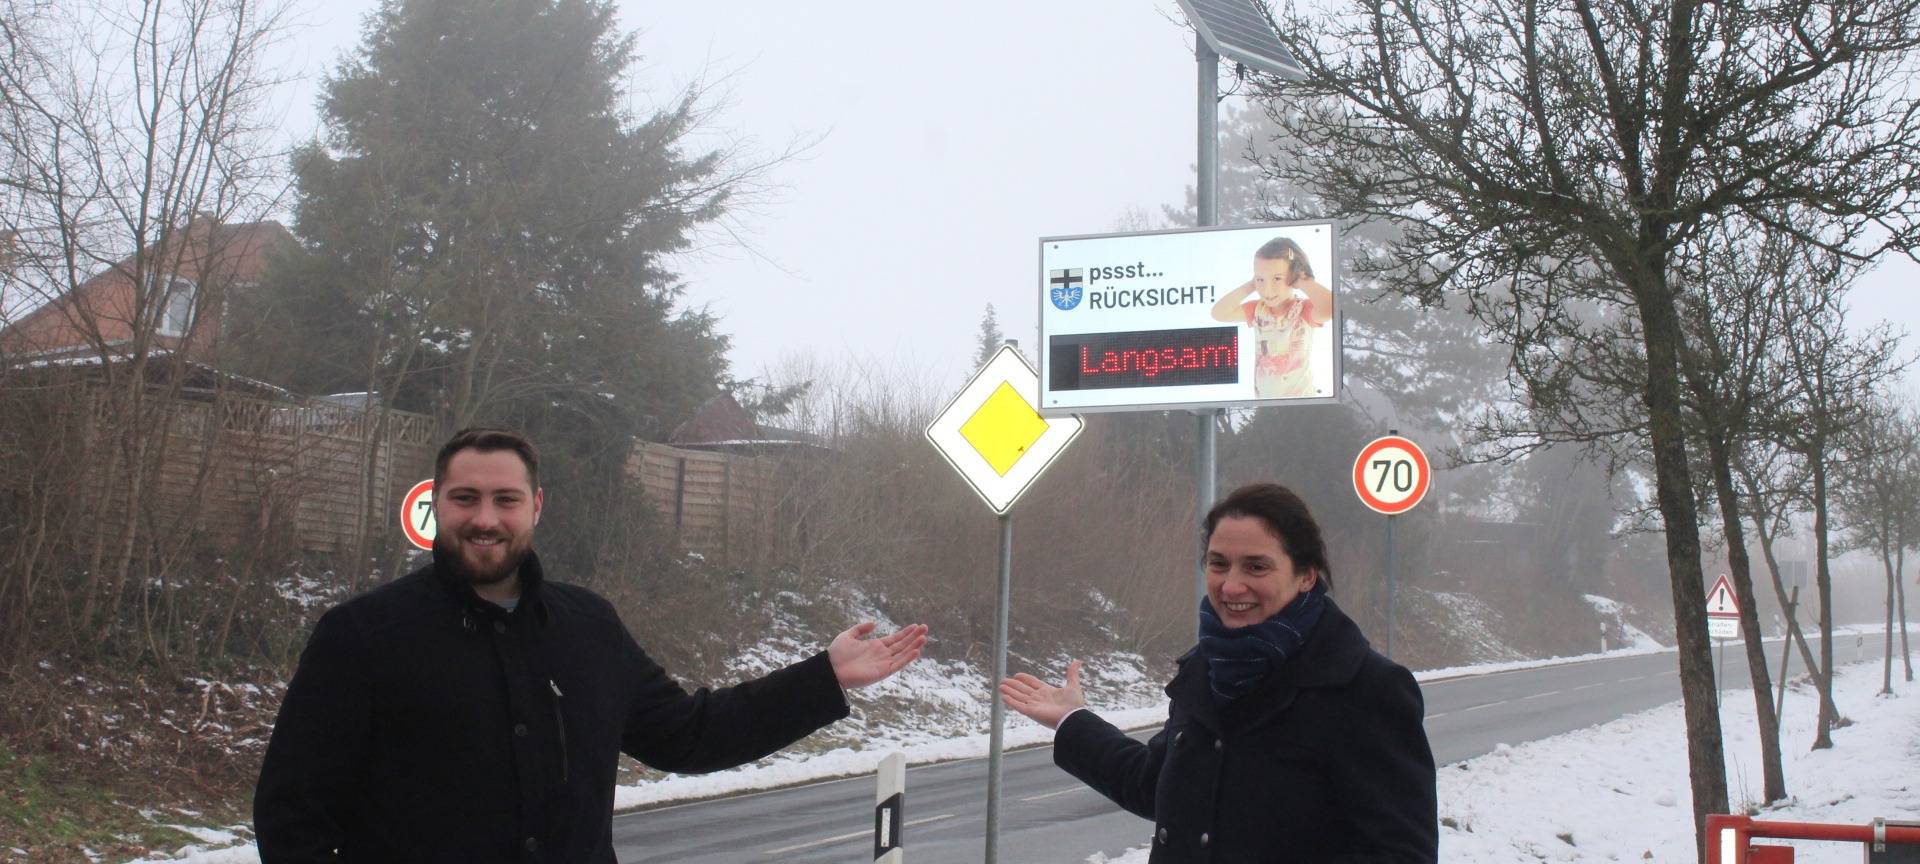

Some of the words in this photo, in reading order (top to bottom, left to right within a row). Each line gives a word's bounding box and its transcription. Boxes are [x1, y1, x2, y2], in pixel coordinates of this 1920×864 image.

[1089, 261, 1163, 285] pssst...
[1090, 286, 1215, 309] RÜCKSICHT!
[1081, 335, 1238, 376] Langsam!
[1373, 460, 1412, 492] 70
[418, 501, 433, 530] 7
